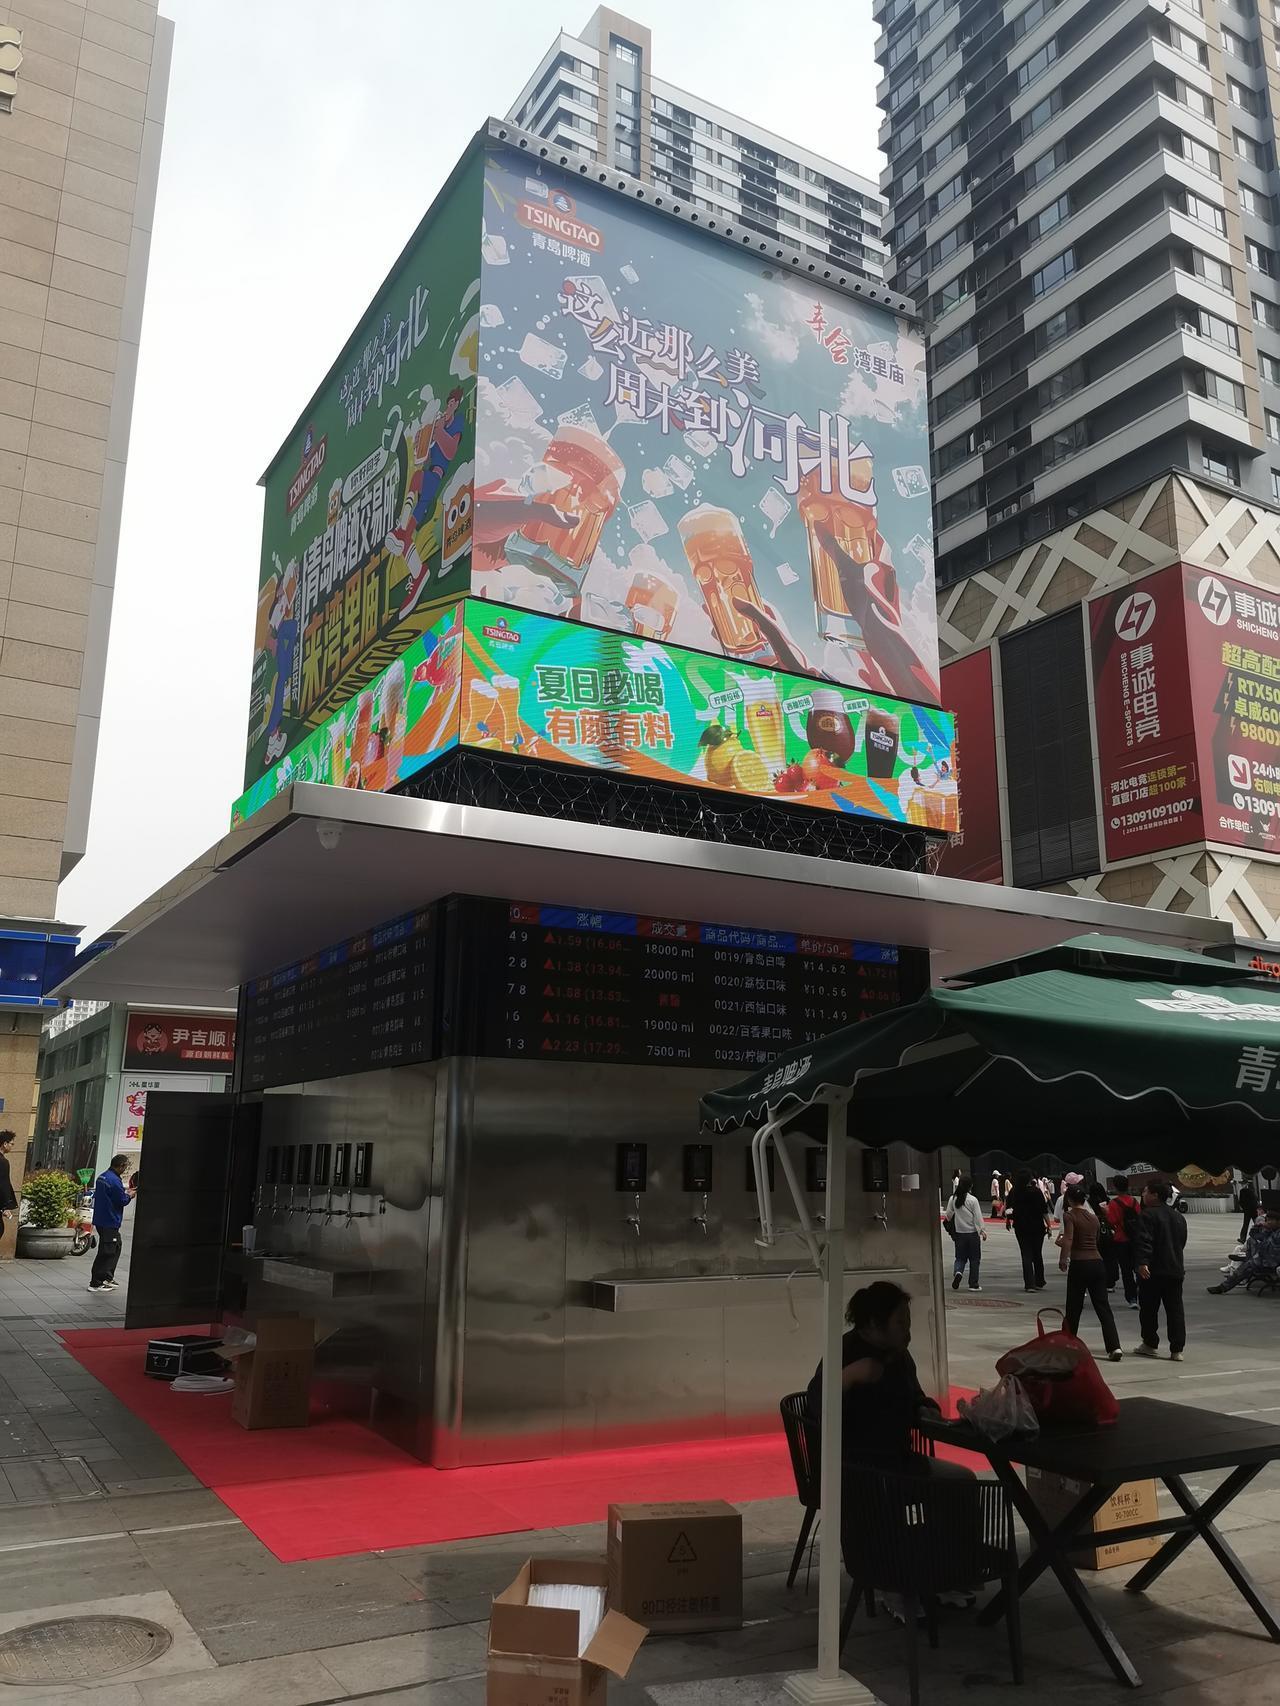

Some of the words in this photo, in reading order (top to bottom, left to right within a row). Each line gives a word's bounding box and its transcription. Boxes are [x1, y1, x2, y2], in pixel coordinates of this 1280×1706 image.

[523, 203, 600, 247] TSINGTAO
[560, 277, 761, 389] 这么近那么美
[853, 346, 905, 387] 湾里庙
[605, 361, 878, 506] 周末到河北
[288, 442, 325, 508] TSINGTAO
[304, 458, 400, 617] 青岛啤酒交易所
[1234, 590, 1280, 629] 事诚
[484, 626, 520, 643] TSINGTAO
[1236, 618, 1279, 642] SHICHENG
[317, 627, 424, 721] TSINGTAO
[1119, 652, 1130, 699] SHICHENG
[1129, 642, 1161, 743] 事诚电竞
[1110, 764, 1188, 794] 河北电竞连锁第一
[1111, 776, 1187, 807] 直营门店超100家
[1120, 797, 1194, 827] 13091091007
[575, 911, 603, 929] 涨幅
[651, 921, 688, 938] 成交量
[644, 943, 679, 956] 18000
[681, 945, 695, 959] ml
[643, 968, 679, 982] 20000
[681, 971, 695, 984] ml
[713, 975, 787, 993] 0020/荔枝口味
[714, 999, 787, 1017] 0021/西柚口味
[172, 1028, 226, 1048] 尹吉顺
[644, 1019, 679, 1033] 19000
[681, 1021, 695, 1033] ml
[708, 1024, 793, 1042] 0022/百香果口味
[647, 1044, 675, 1057] 7500
[677, 1047, 692, 1058] ml
[1235, 1045, 1280, 1093] 青
